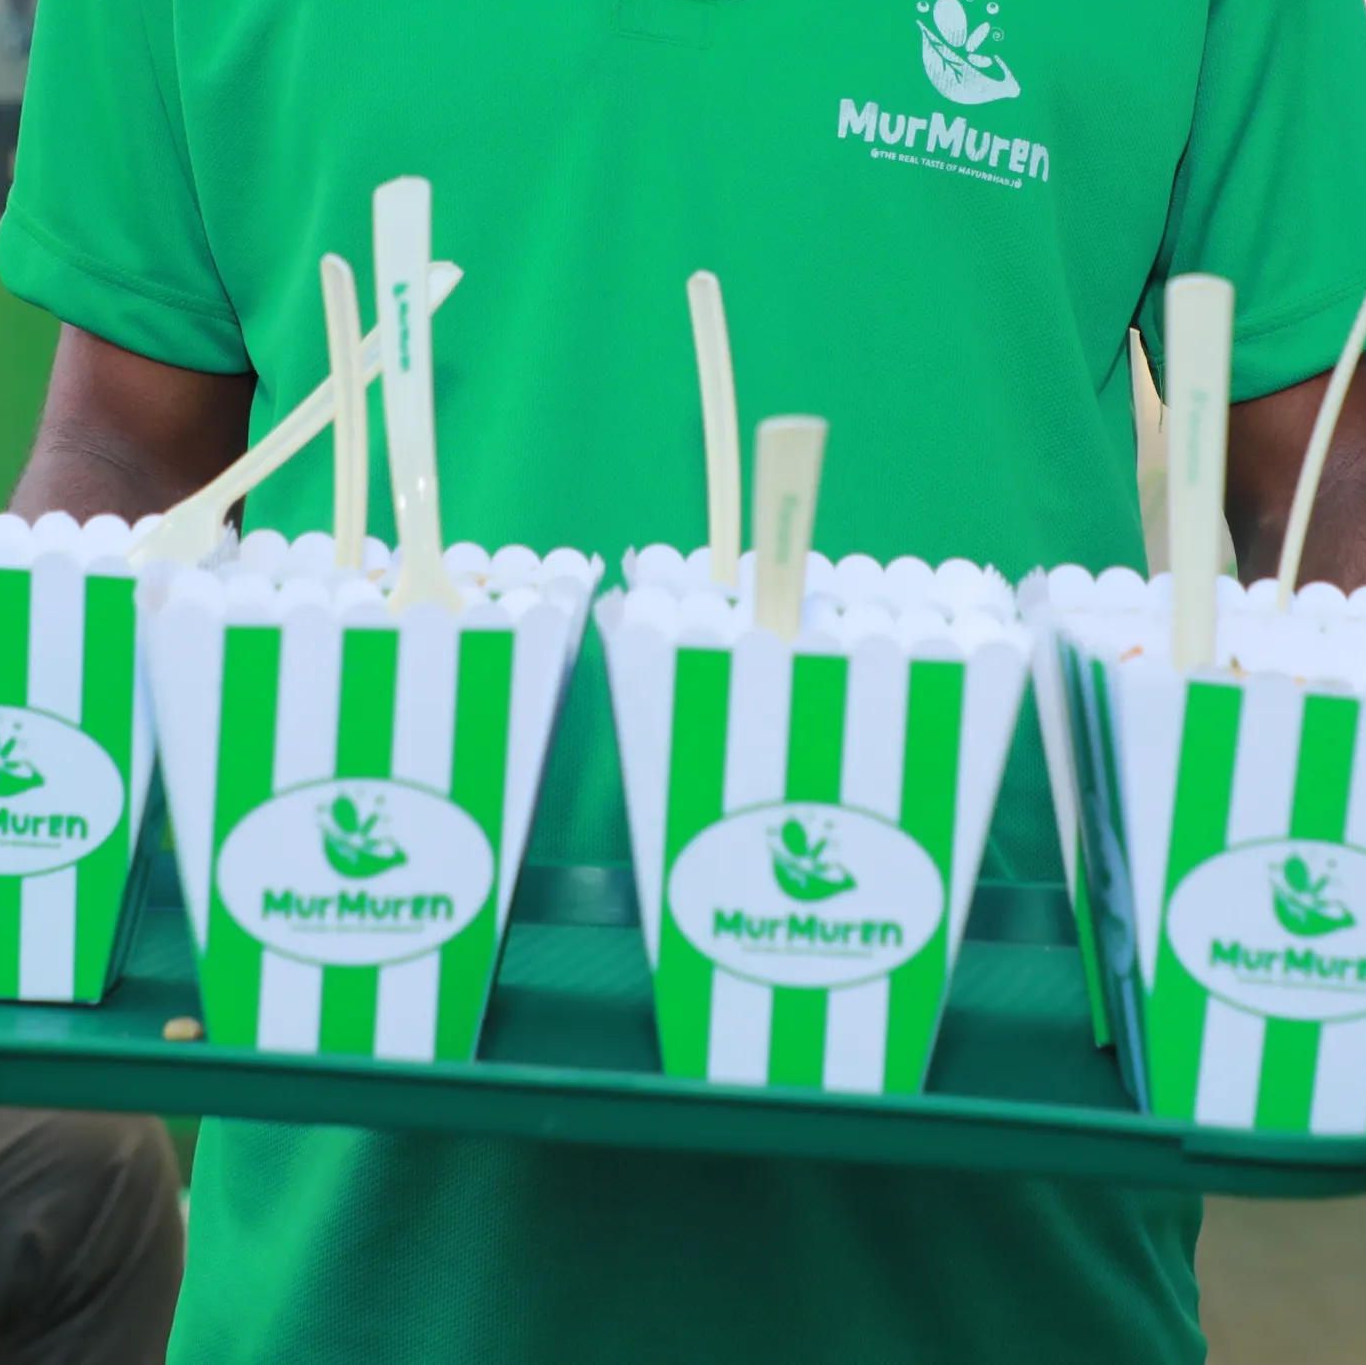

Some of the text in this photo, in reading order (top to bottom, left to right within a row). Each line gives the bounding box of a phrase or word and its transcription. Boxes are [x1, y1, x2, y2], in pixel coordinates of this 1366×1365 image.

[838, 98, 1050, 182] MurMuren
[879, 150, 897, 161] THE
[898, 153, 919, 165] REAL
[921, 157, 945, 170] TASTE
[946, 164, 958, 172] OF
